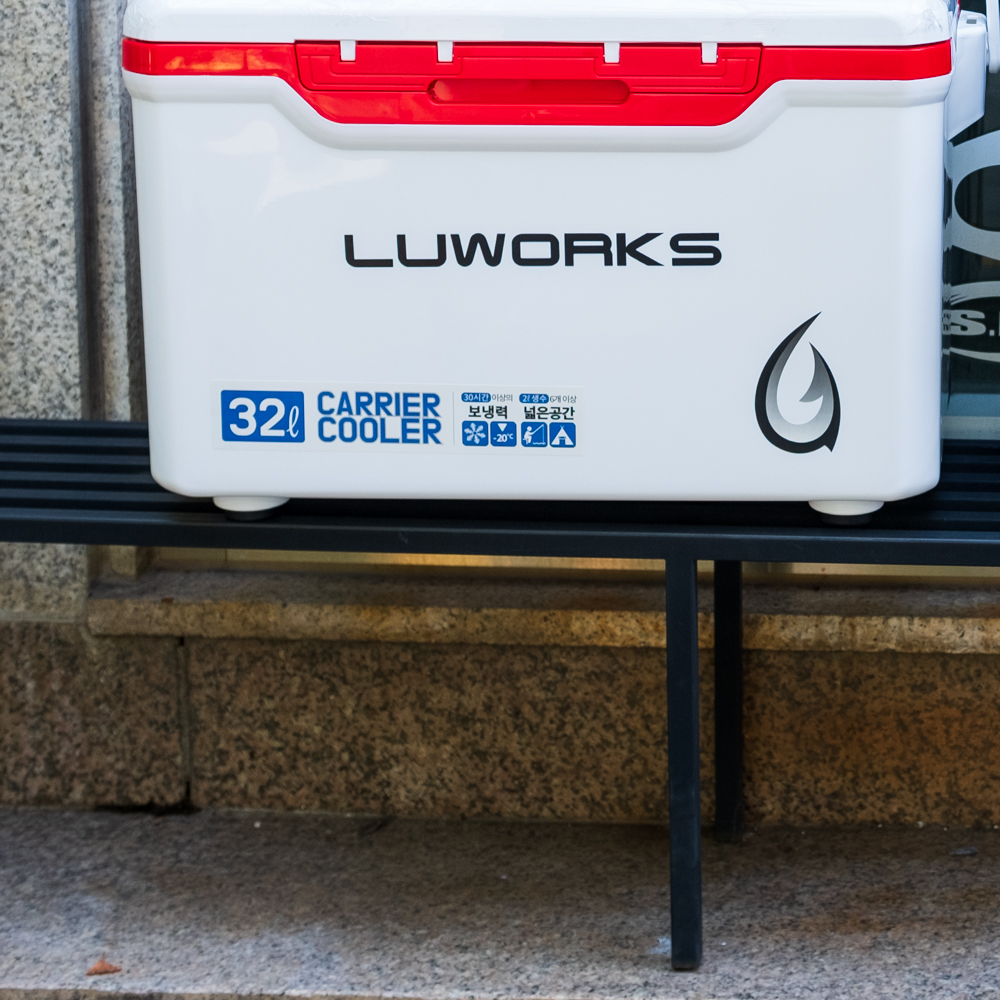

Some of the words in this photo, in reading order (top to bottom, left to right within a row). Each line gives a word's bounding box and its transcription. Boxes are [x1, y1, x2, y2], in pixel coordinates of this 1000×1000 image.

[344, 232, 722, 268] LUWORKS
[317, 391, 442, 418] CARRIER
[463, 393, 490, 402] 30시간
[468, 405, 508, 419] 보냉력
[317, 417, 443, 444] COOLER
